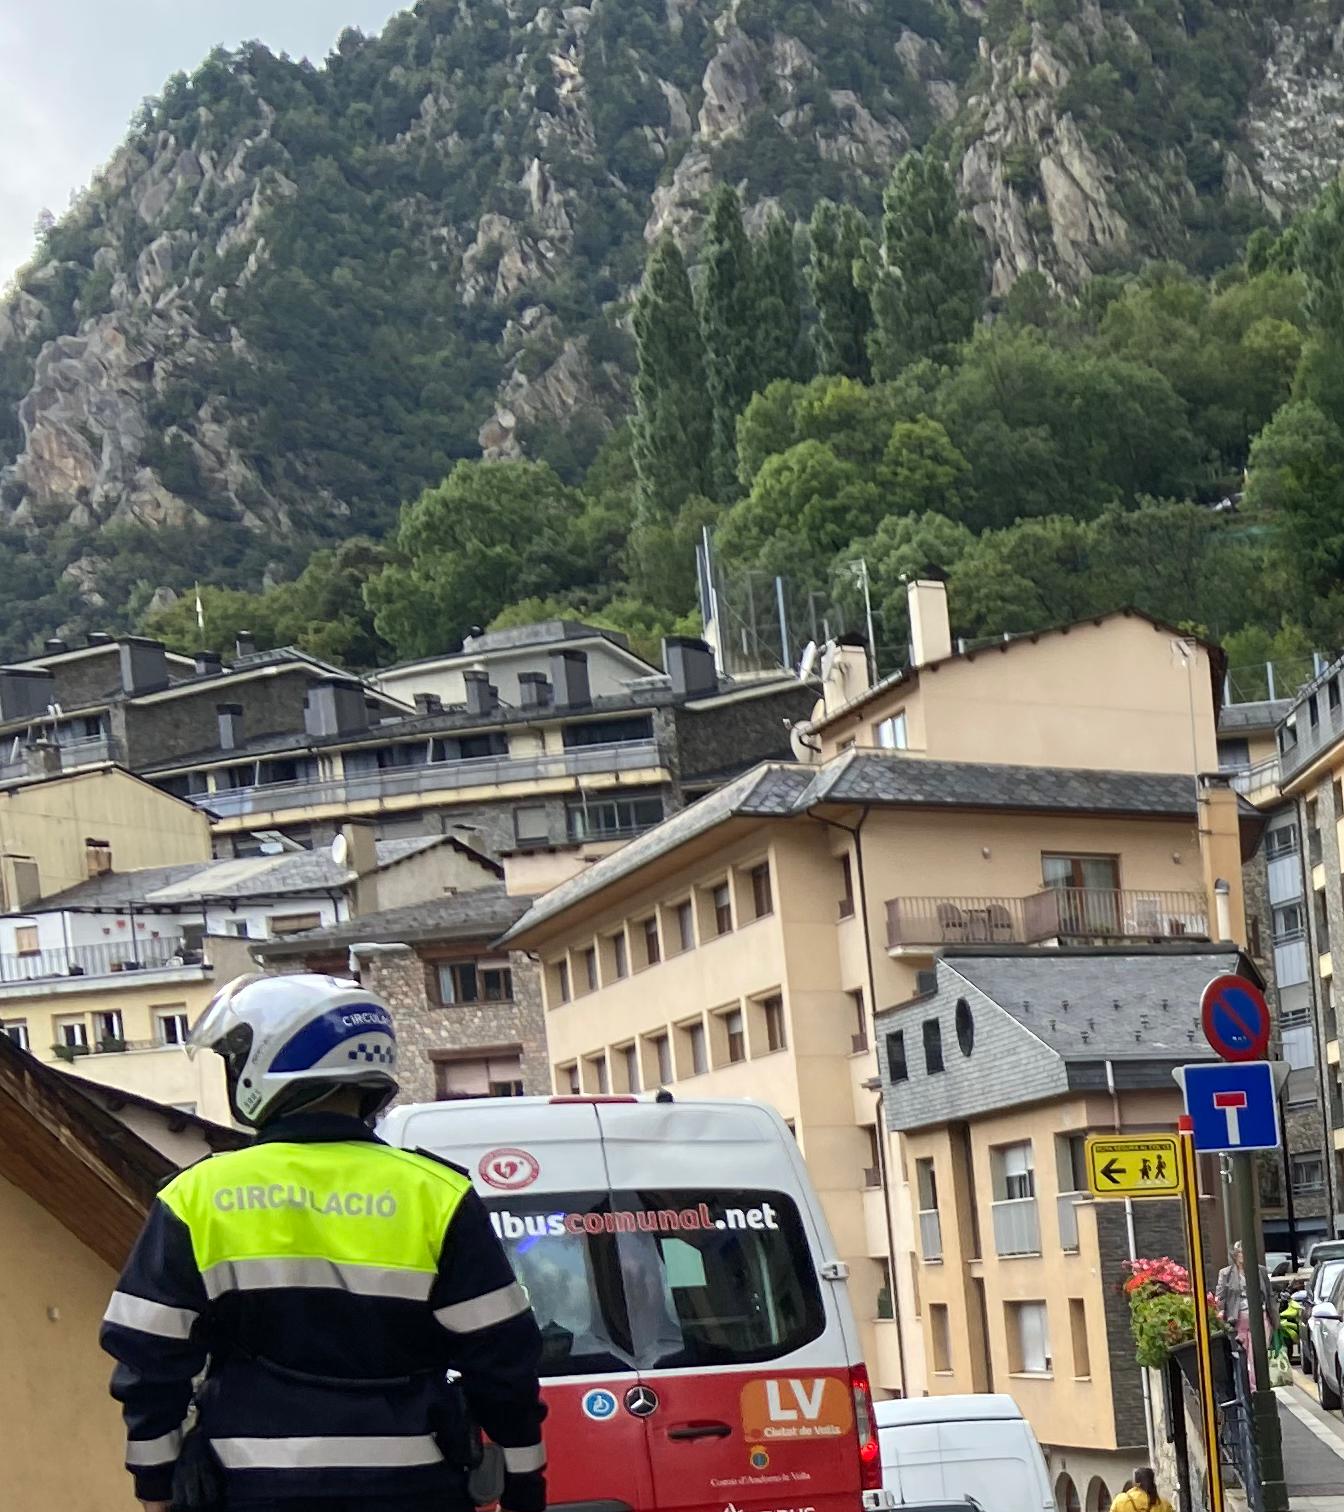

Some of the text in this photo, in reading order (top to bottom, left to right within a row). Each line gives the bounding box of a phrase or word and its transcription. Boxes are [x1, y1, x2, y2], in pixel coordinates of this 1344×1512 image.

[342, 1012, 391, 1027] CIRCULA
[214, 1183, 398, 1218] CIRCULACIÓ
[489, 1203, 780, 1239] lbuscomunal.net
[765, 1378, 826, 1422] LV
